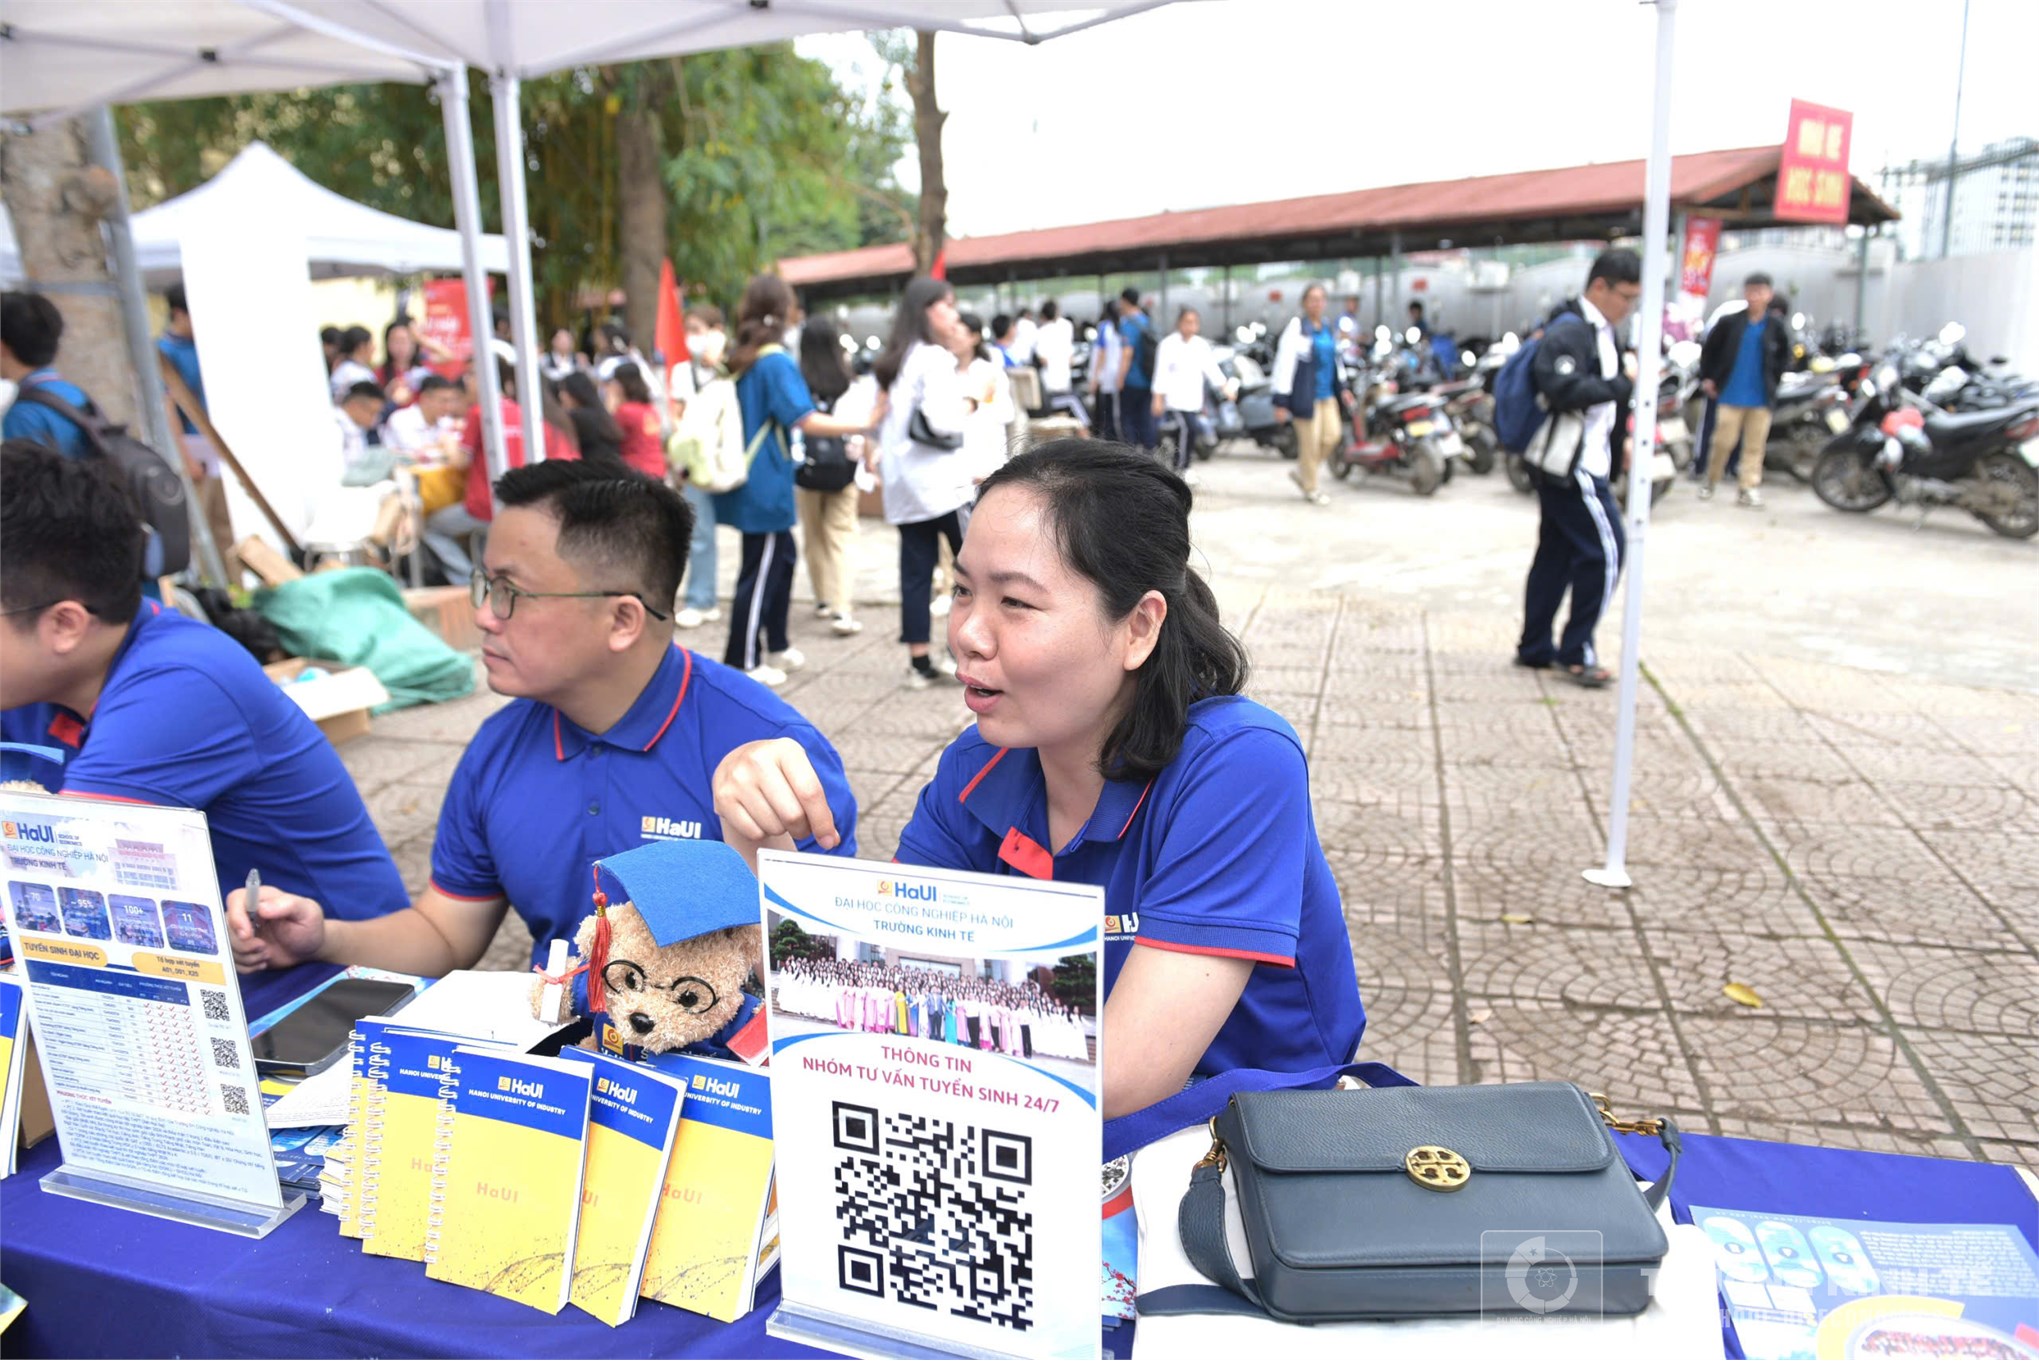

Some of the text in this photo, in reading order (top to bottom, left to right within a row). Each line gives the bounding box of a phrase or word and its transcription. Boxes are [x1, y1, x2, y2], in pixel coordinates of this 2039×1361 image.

[17, 822, 55, 843] HaUI
[656, 818, 702, 839] HaUI
[36, 845, 56, 857] CÔNG
[57, 849, 82, 860] NGHIỆP
[84, 851, 94, 861] HÀ
[96, 854, 109, 863] NỘI
[894, 881, 937, 902] HaUI
[123, 905, 144, 915] 100+
[182, 912, 192, 922] 11
[835, 896, 855, 911] ĐẠI
[885, 900, 919, 917] CÔNG
[922, 907, 967, 924] NGHIỆP
[970, 911, 988, 925] HÀ
[991, 914, 1014, 929] NỘI
[873, 919, 975, 943] TRƯỜNG KINH TẾ
[24, 942, 100, 960] TUYỂN SINH ĐẠI HỌC
[881, 1046, 972, 1073] THÔNG TIN
[400, 1068, 420, 1077] HANOI
[511, 1078, 544, 1099] HaUI
[608, 1081, 638, 1105] HaUI
[705, 1076, 740, 1099] HaUI
[803, 1056, 1060, 1113] NHÓM TƯ VẤN TUYỂN SINH 24/7
[468, 1089, 566, 1115] HANOI UNIVERSITY OF INDUSTRY
[591, 1095, 620, 1110] NIVERSITY
[628, 1108, 653, 1124] INDUSTRY
[730, 1102, 762, 1115] INDUSTRY
[476, 1181, 519, 1203] HaUI
